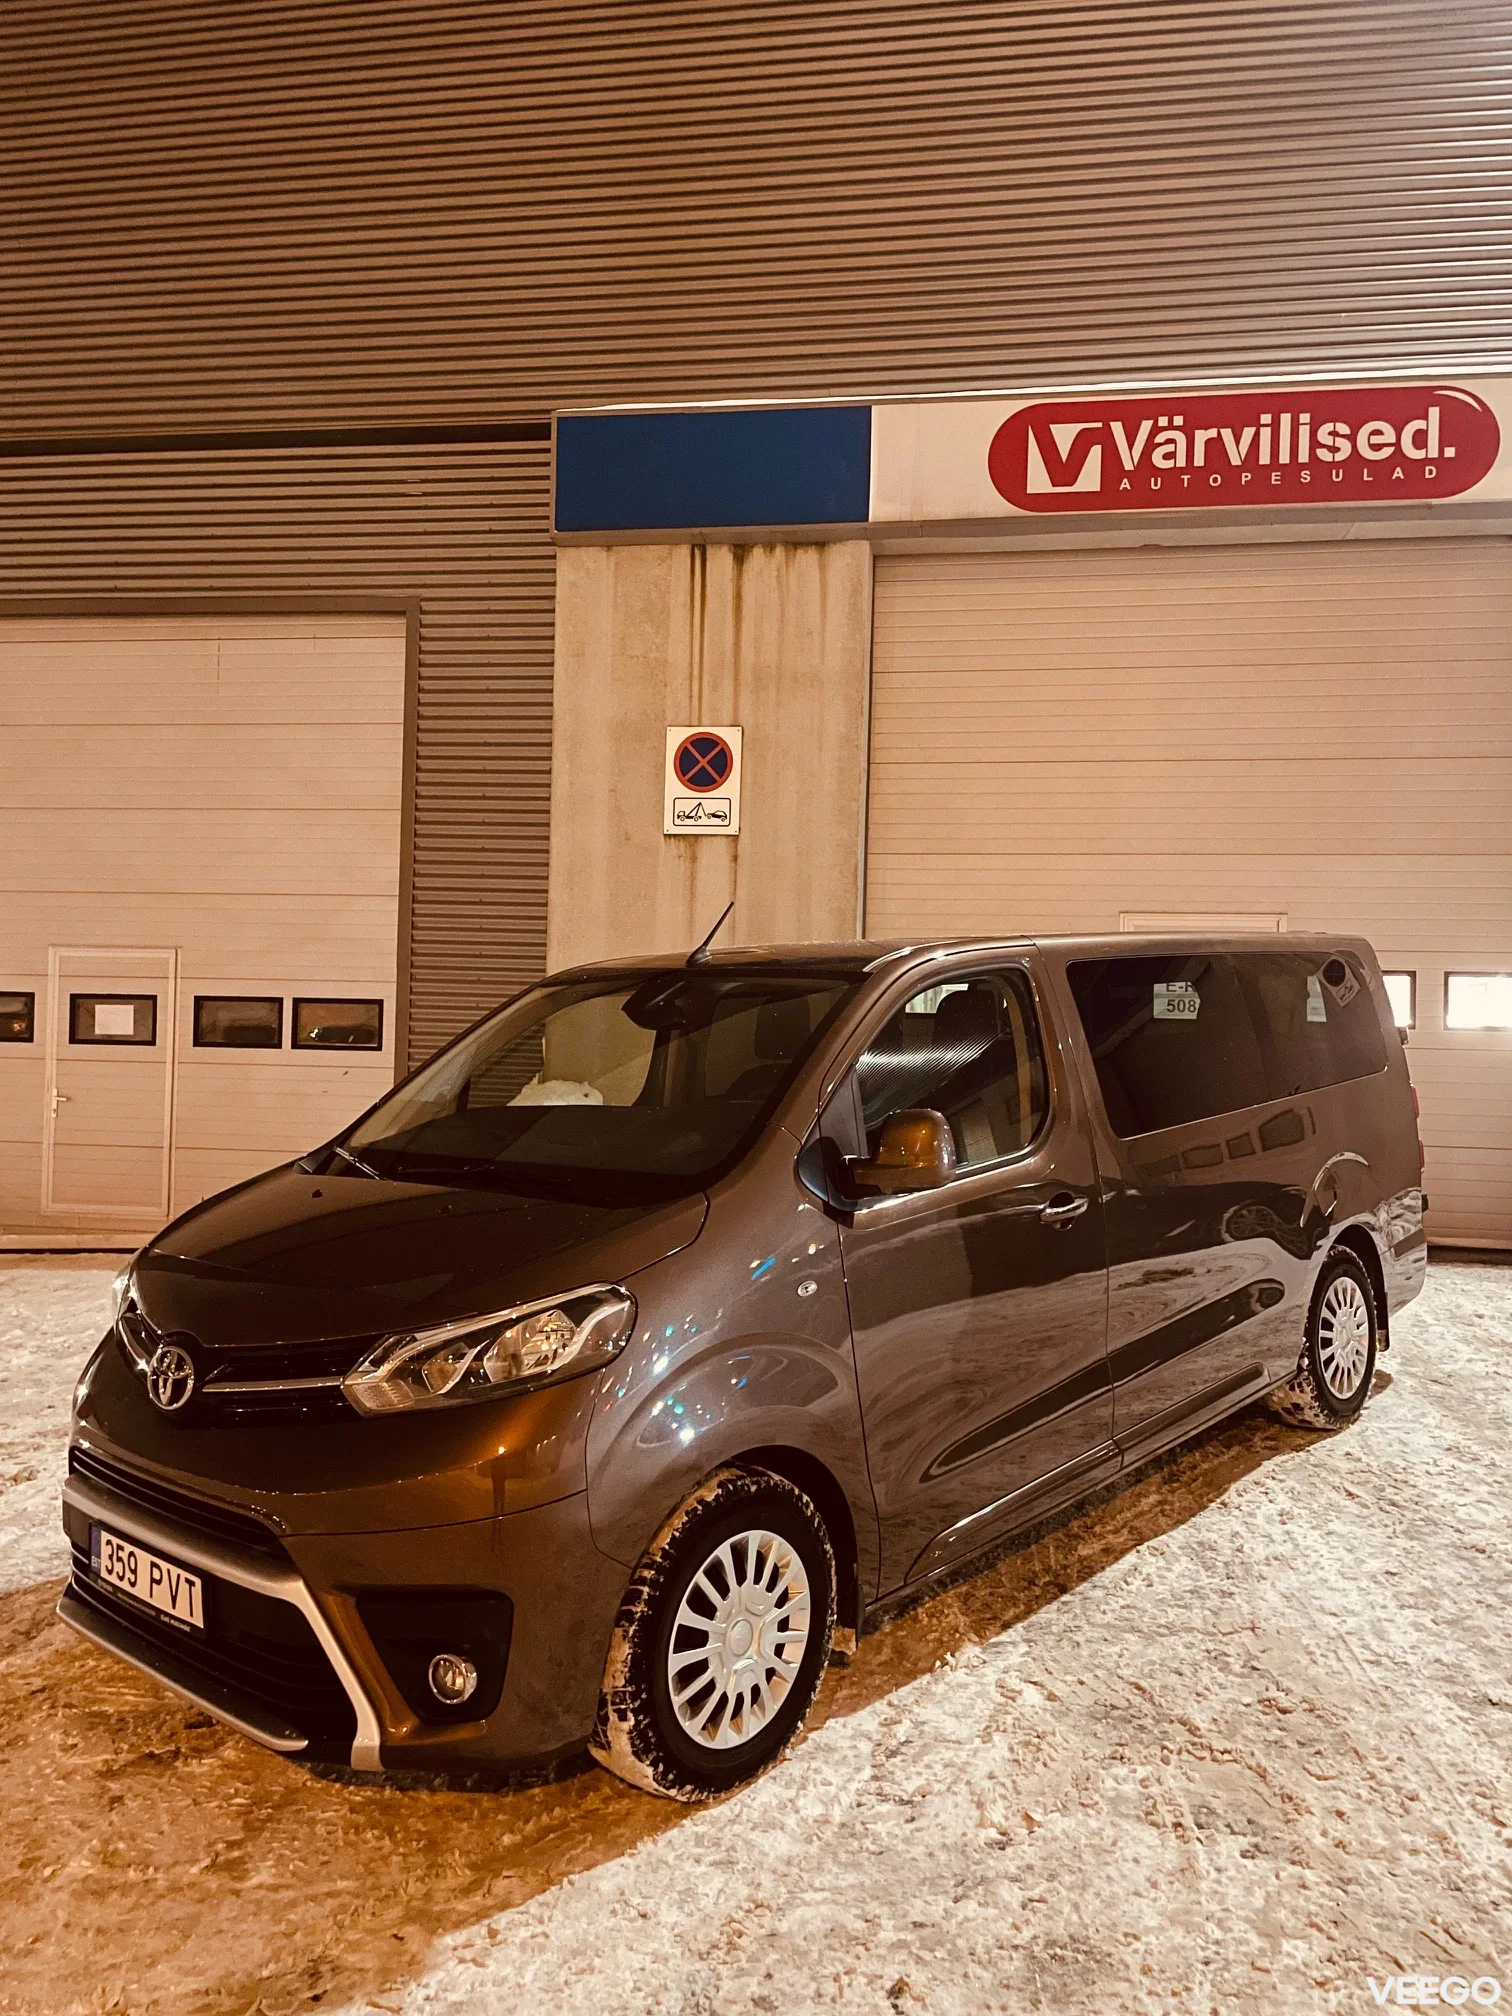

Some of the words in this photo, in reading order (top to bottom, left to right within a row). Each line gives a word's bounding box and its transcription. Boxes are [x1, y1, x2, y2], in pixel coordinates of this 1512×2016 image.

[1109, 406, 1456, 471] Värvilised.
[1119, 465, 1438, 491] AUTOPESULAD
[1166, 999, 1197, 1013] 508
[105, 1538, 138, 1588] 359
[150, 1560, 196, 1618] PVT
